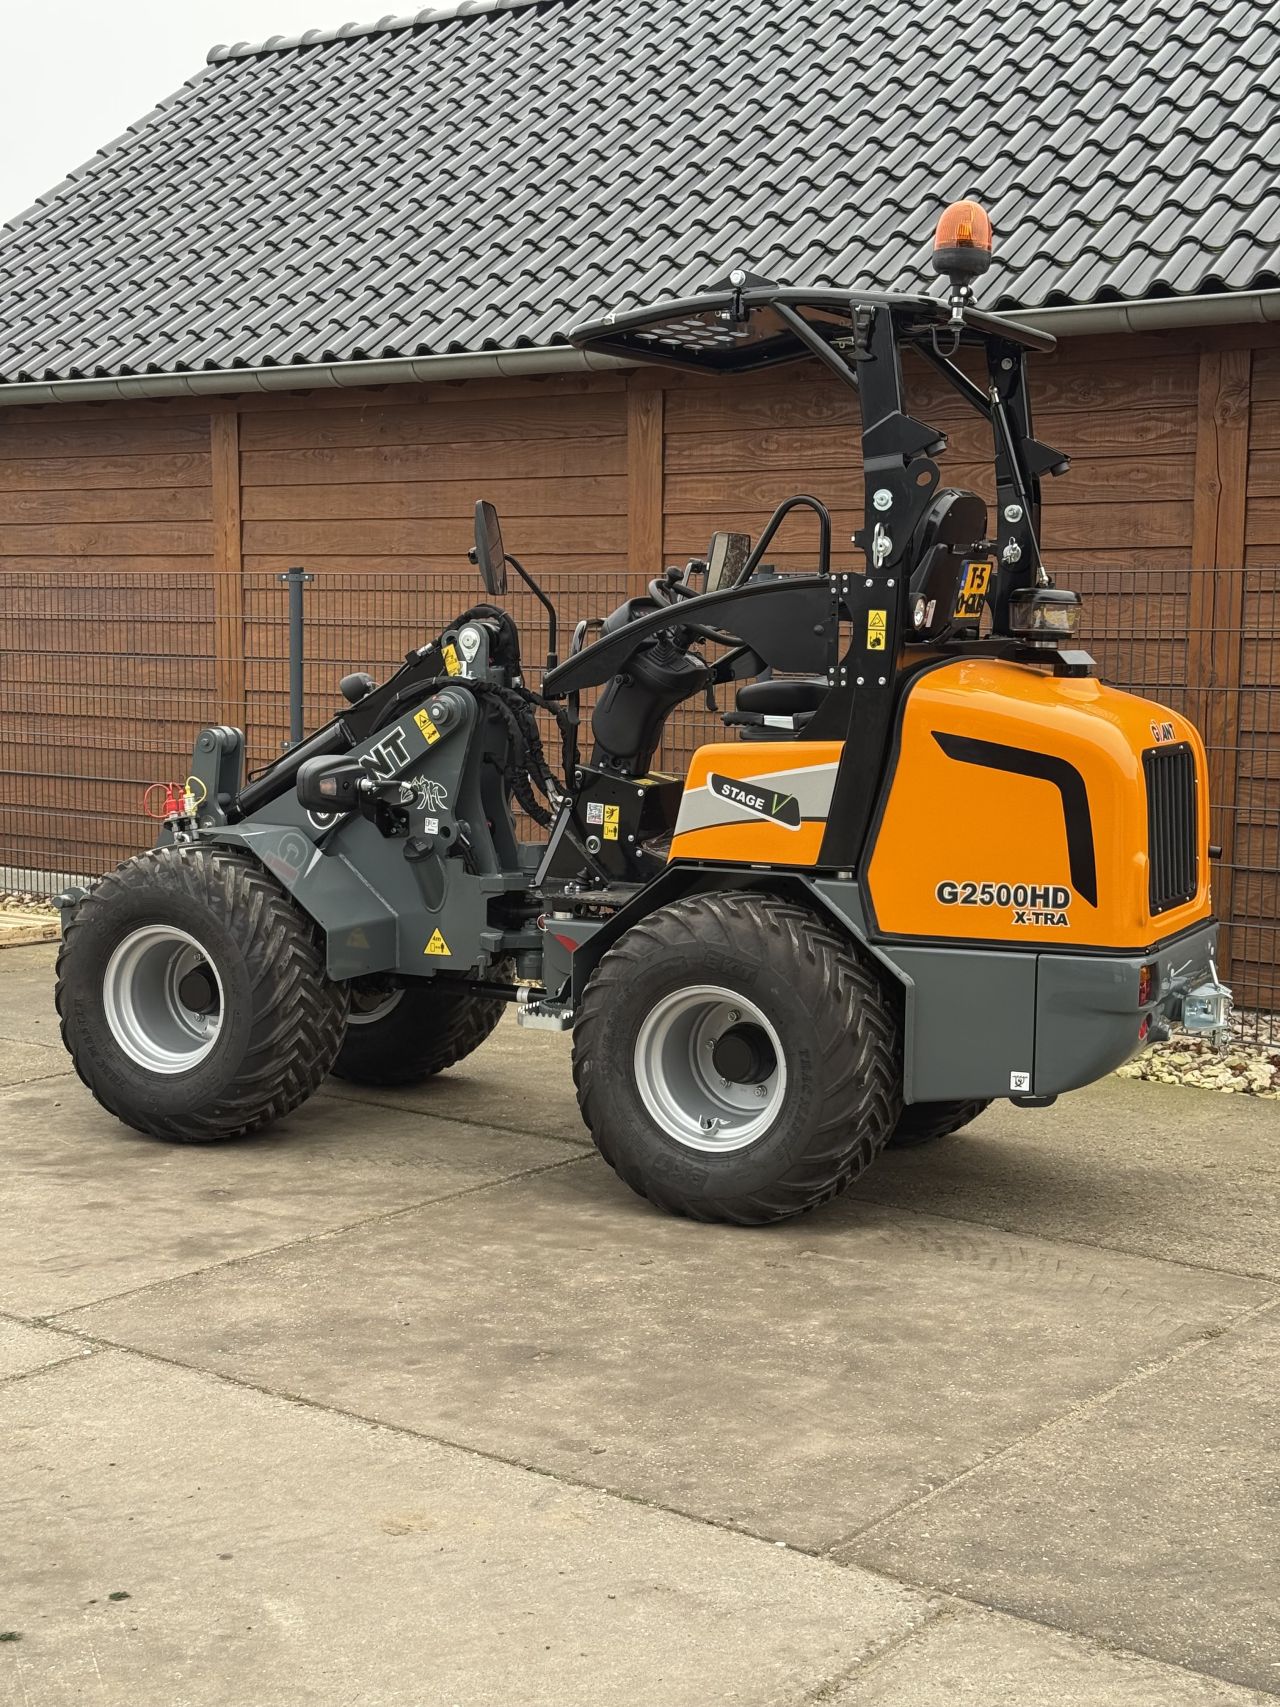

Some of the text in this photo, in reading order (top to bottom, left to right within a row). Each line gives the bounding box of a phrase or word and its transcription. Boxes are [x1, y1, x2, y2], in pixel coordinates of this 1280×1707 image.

[721, 784, 793, 815] STAGE V
[936, 880, 1072, 910] G2500HD
[1012, 910, 1071, 927] X-TRA
